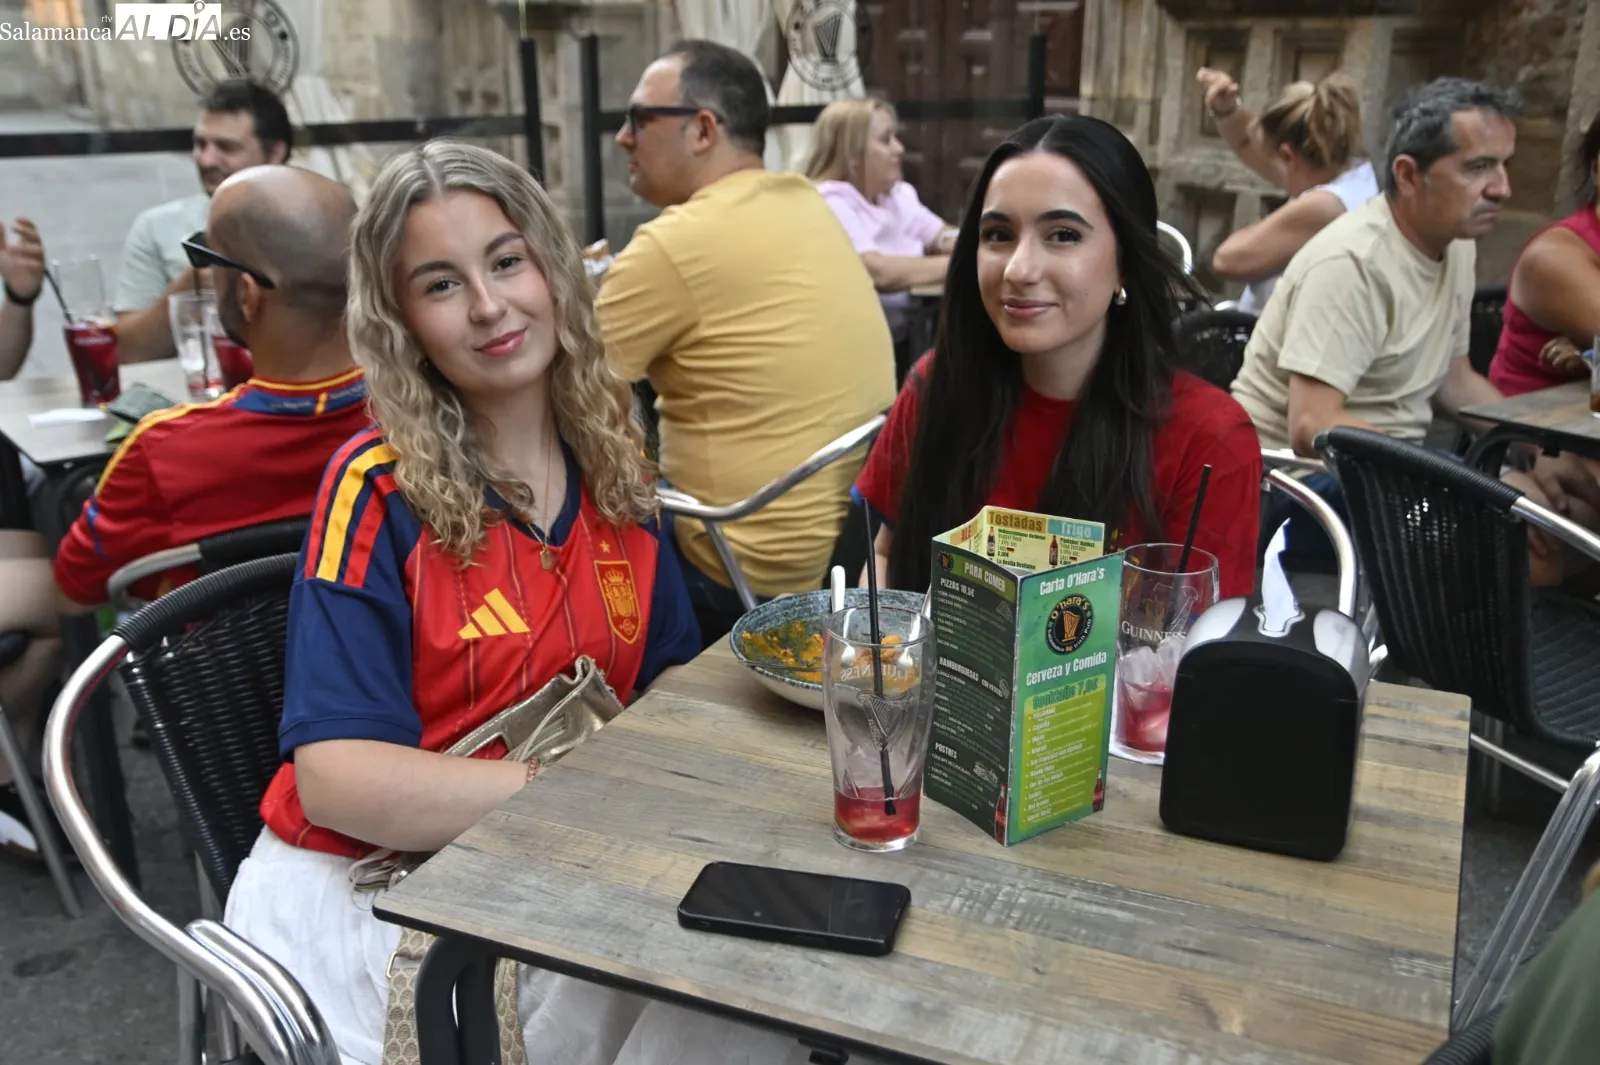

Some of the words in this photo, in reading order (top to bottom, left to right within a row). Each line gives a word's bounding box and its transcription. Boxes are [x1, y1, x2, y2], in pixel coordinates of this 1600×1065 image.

[989, 511, 1043, 533] Tostadas
[1060, 521, 1092, 538] Trigo
[940, 577, 960, 592] PIZZAS
[964, 561, 983, 581] PARA
[984, 570, 1006, 593] COMER
[1040, 577, 1065, 596] Carta
[1066, 567, 1105, 589] O'Hara's
[1121, 620, 1187, 641] GUINNESS
[1026, 664, 1063, 686] Cerveza
[1065, 662, 1072, 676] y
[1072, 652, 1107, 672] Comida
[935, 742, 957, 759] POSTRES
